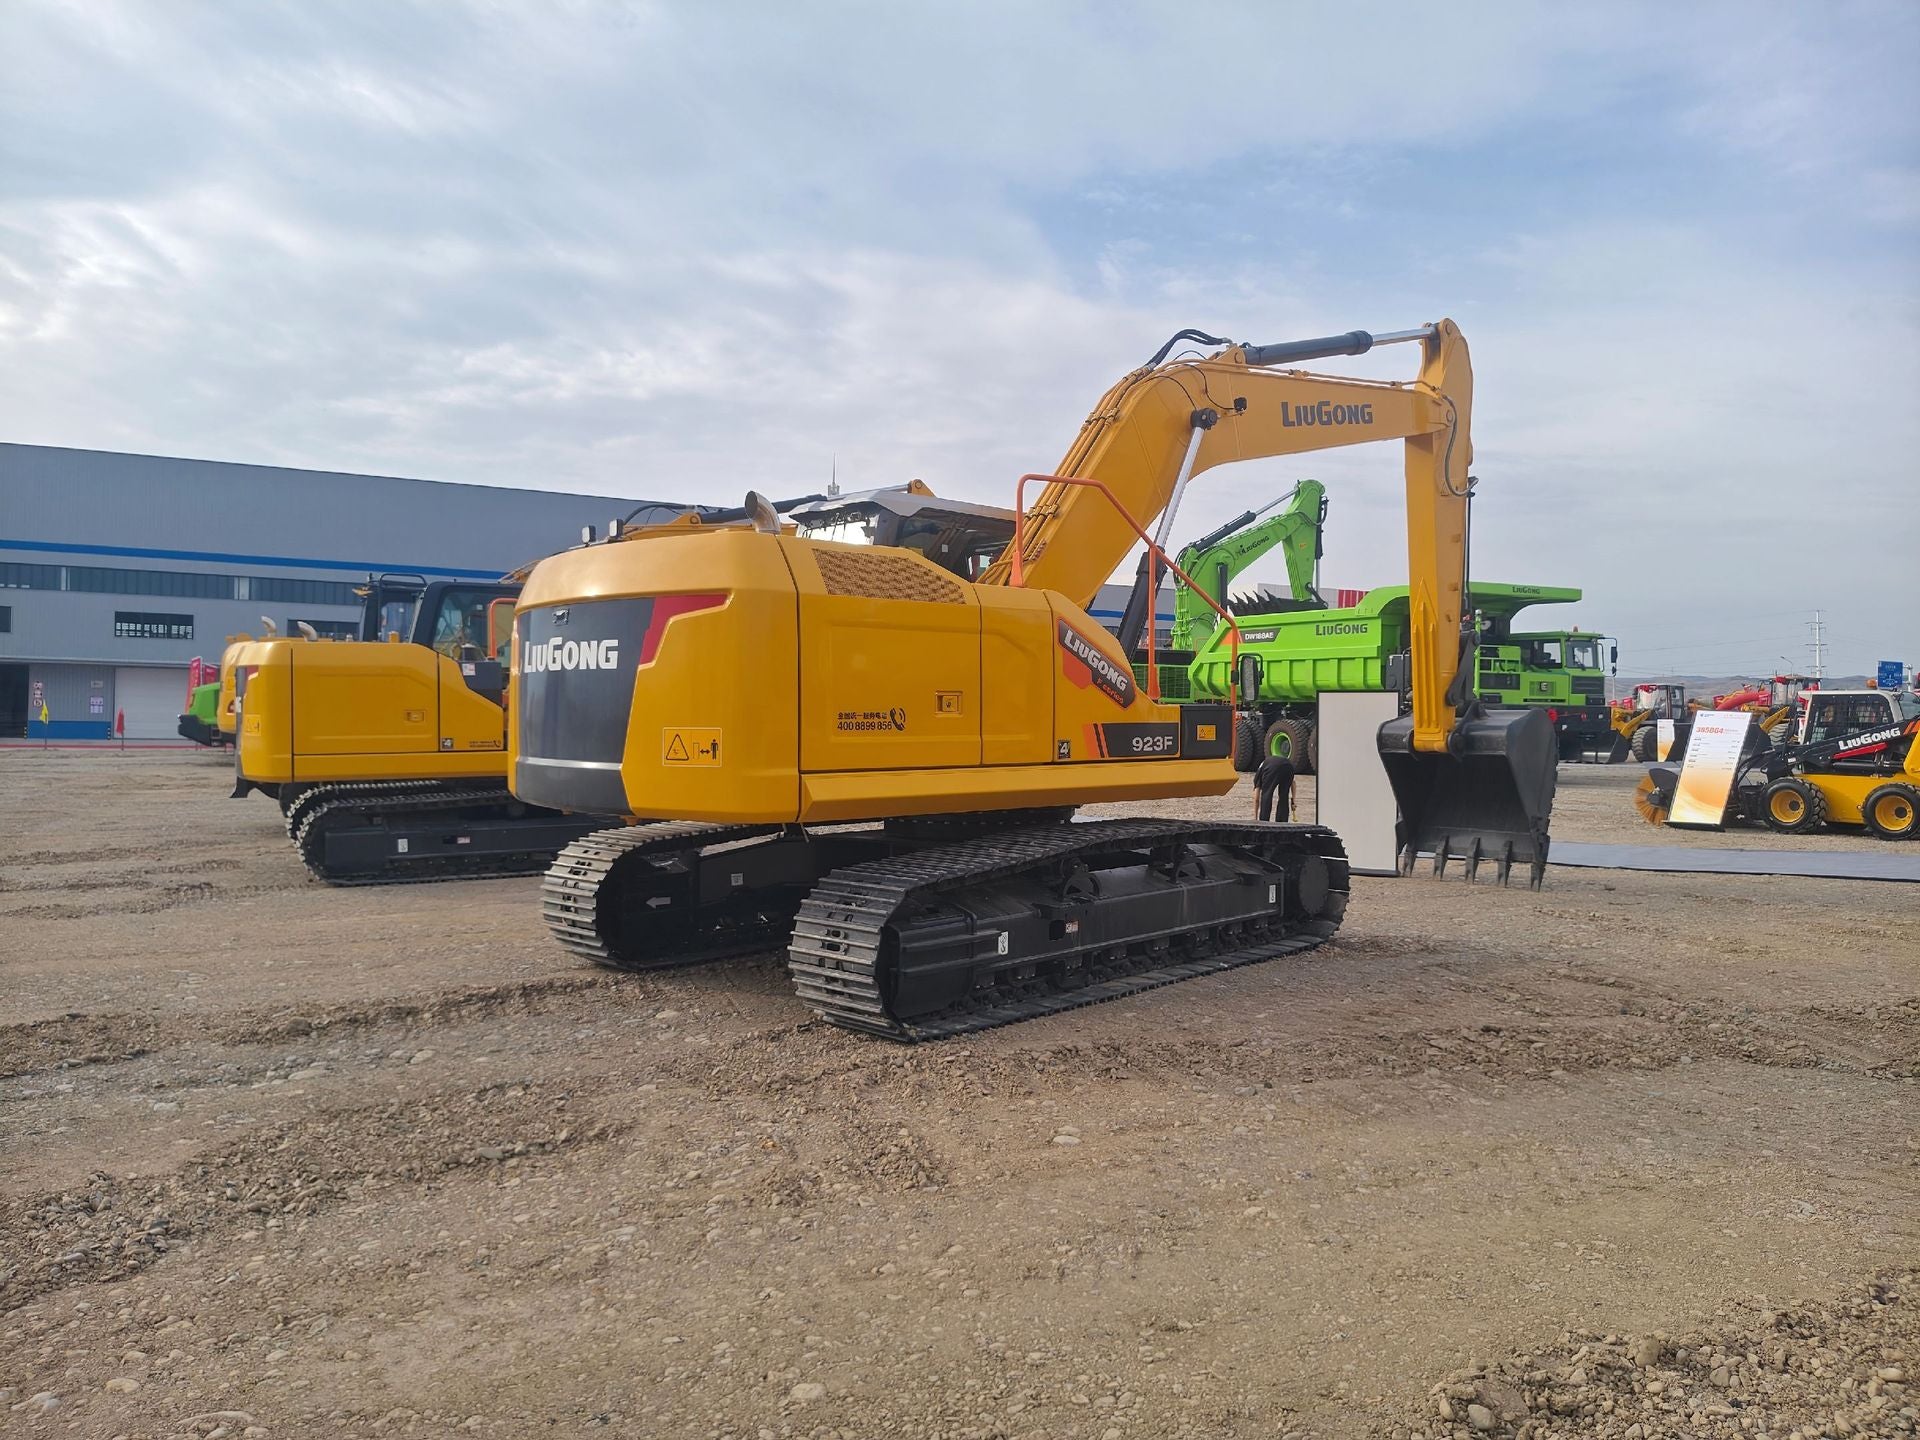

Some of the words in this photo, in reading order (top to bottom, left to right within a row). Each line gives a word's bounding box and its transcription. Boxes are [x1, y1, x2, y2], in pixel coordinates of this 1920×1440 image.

[837, 721, 853, 730] 400
[855, 721, 876, 730] 8899
[877, 721, 892, 730] 856
[1132, 736, 1173, 751] 923F
